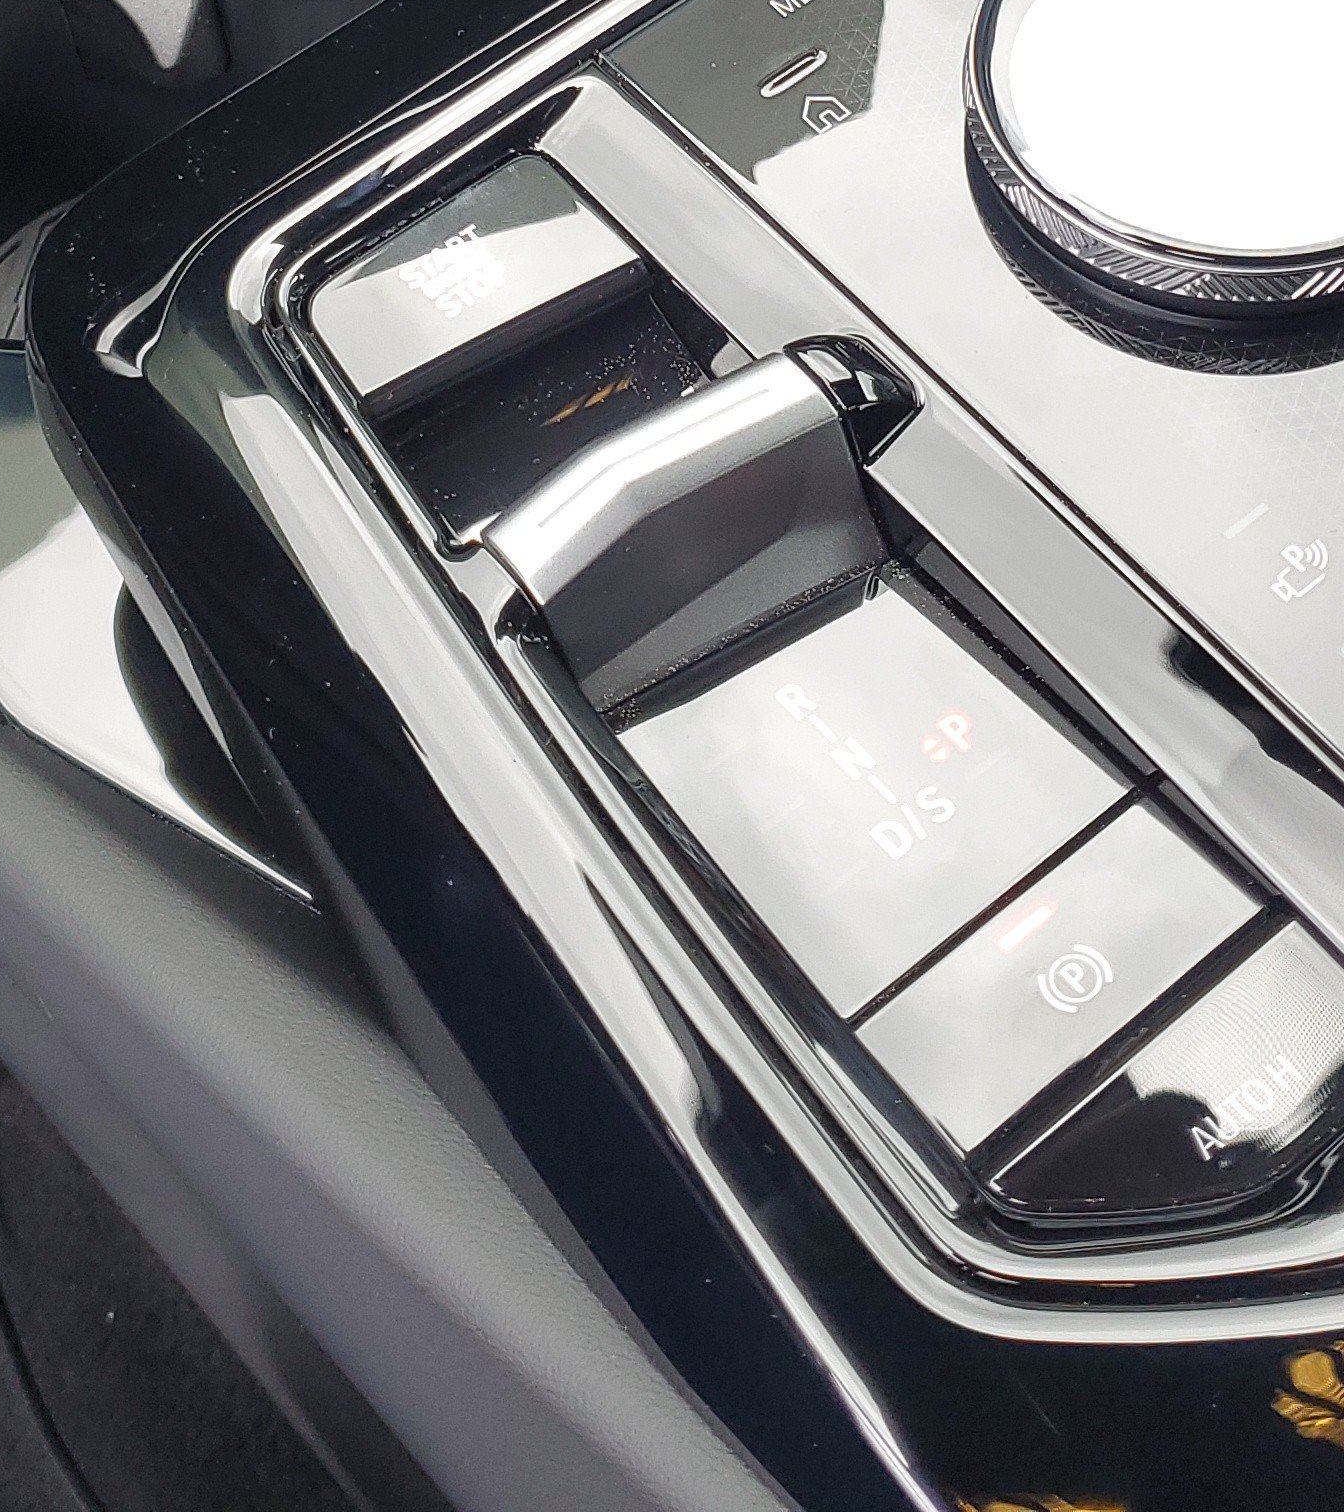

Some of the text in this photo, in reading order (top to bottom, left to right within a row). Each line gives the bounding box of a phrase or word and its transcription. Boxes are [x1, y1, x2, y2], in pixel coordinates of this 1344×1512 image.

[774, 683, 818, 722] R
[936, 713, 972, 752] P
[830, 736, 877, 781] N
[1191, 1054, 1303, 1162] AUTO H
